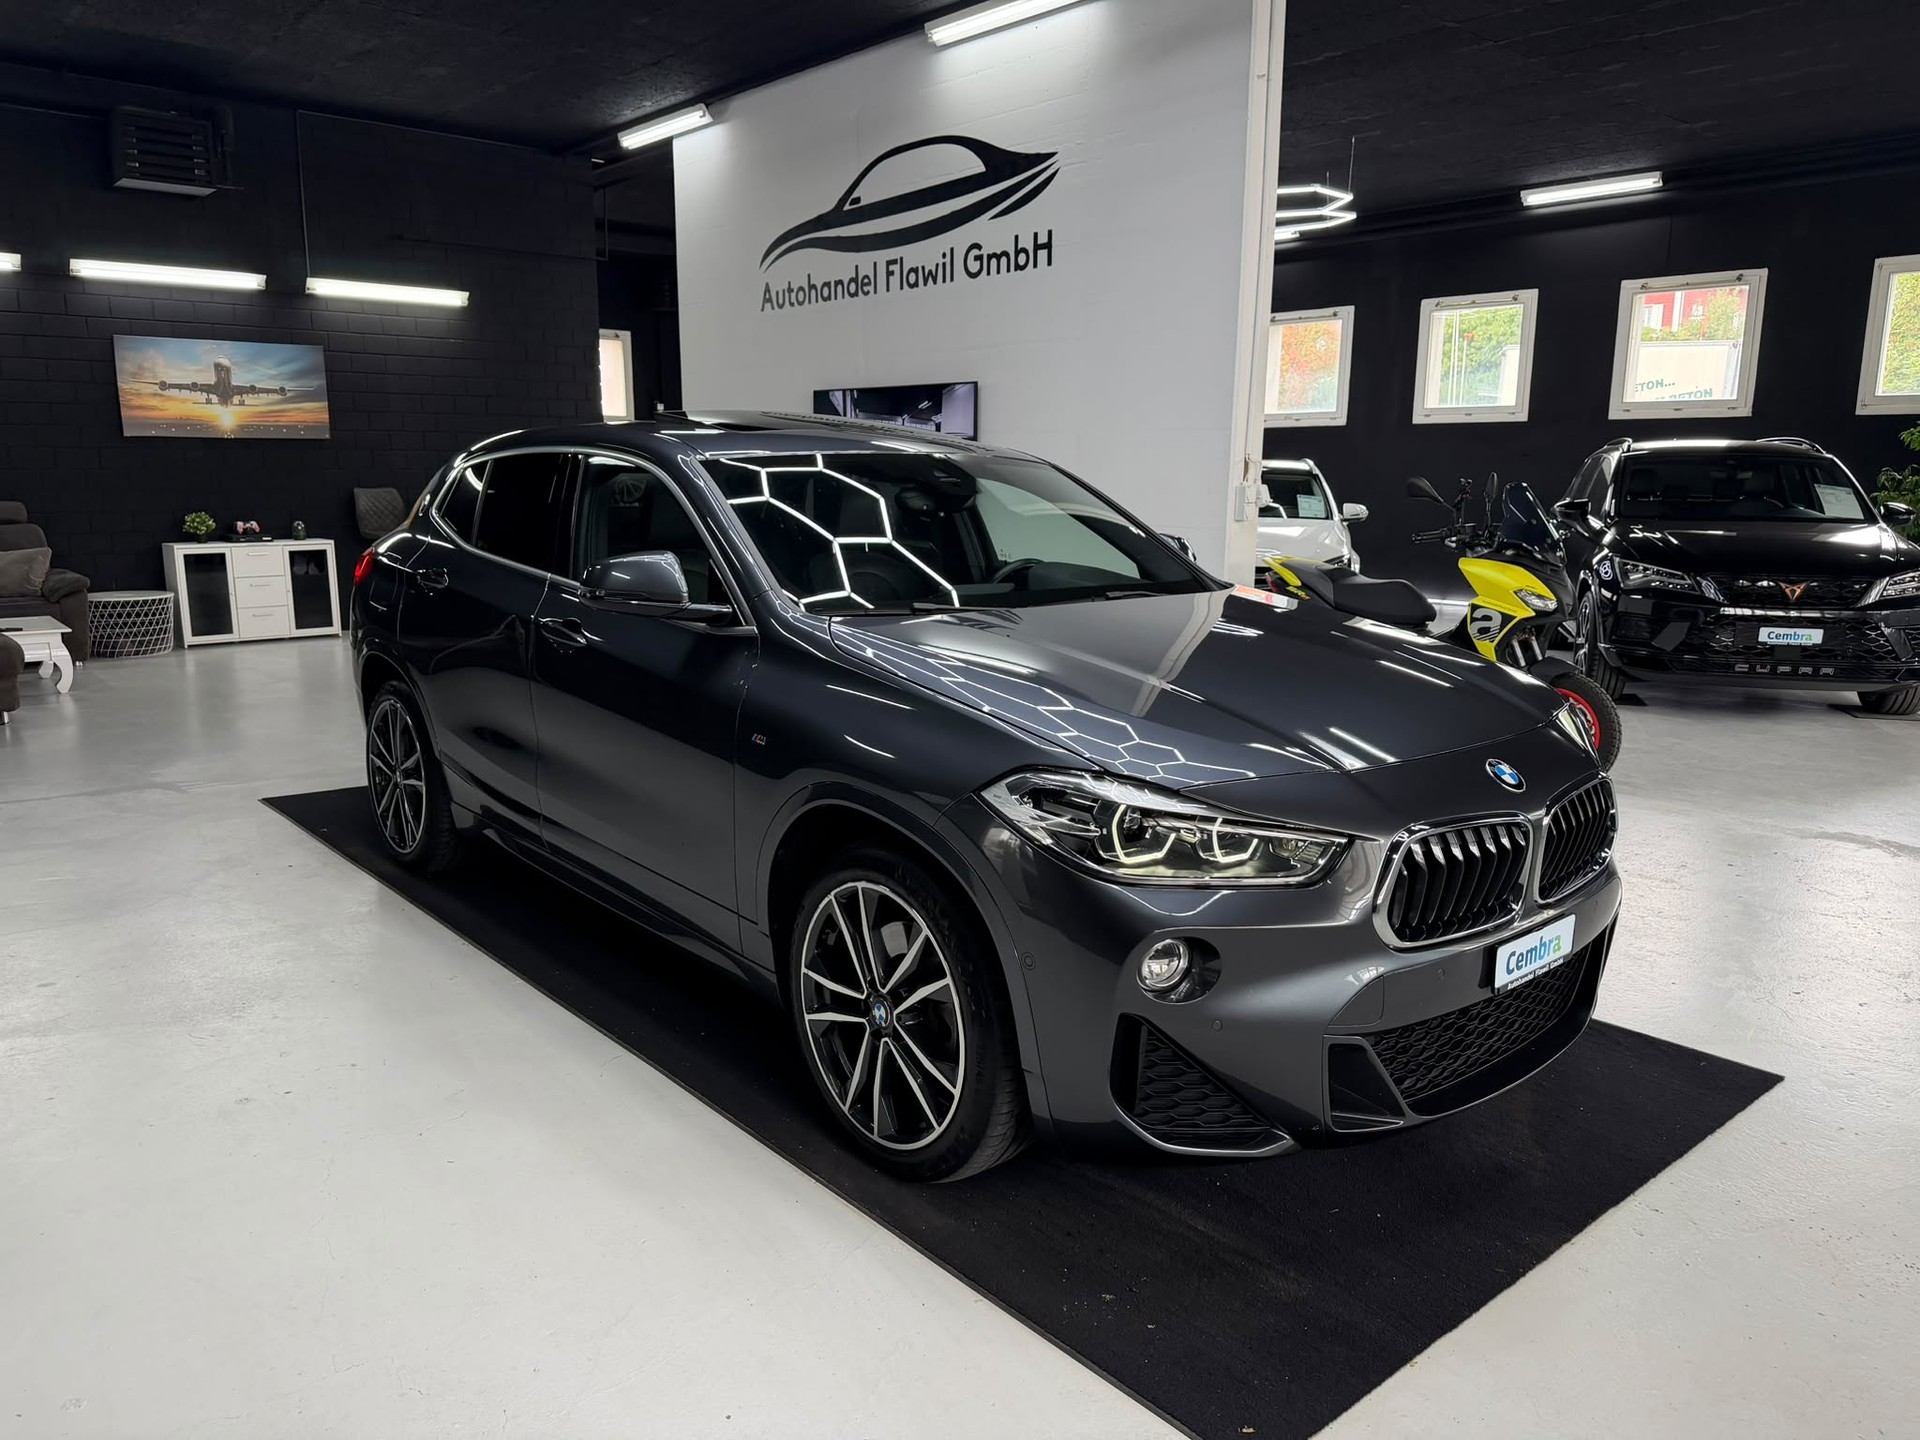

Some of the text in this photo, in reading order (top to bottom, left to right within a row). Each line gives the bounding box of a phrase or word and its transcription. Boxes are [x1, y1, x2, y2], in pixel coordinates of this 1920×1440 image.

[761, 229, 1053, 312] Autohandel Flawil GmbH
[1767, 631, 1813, 642] Cembra
[1735, 664, 1835, 676] CUPRA
[1506, 934, 1562, 976] Cembra
